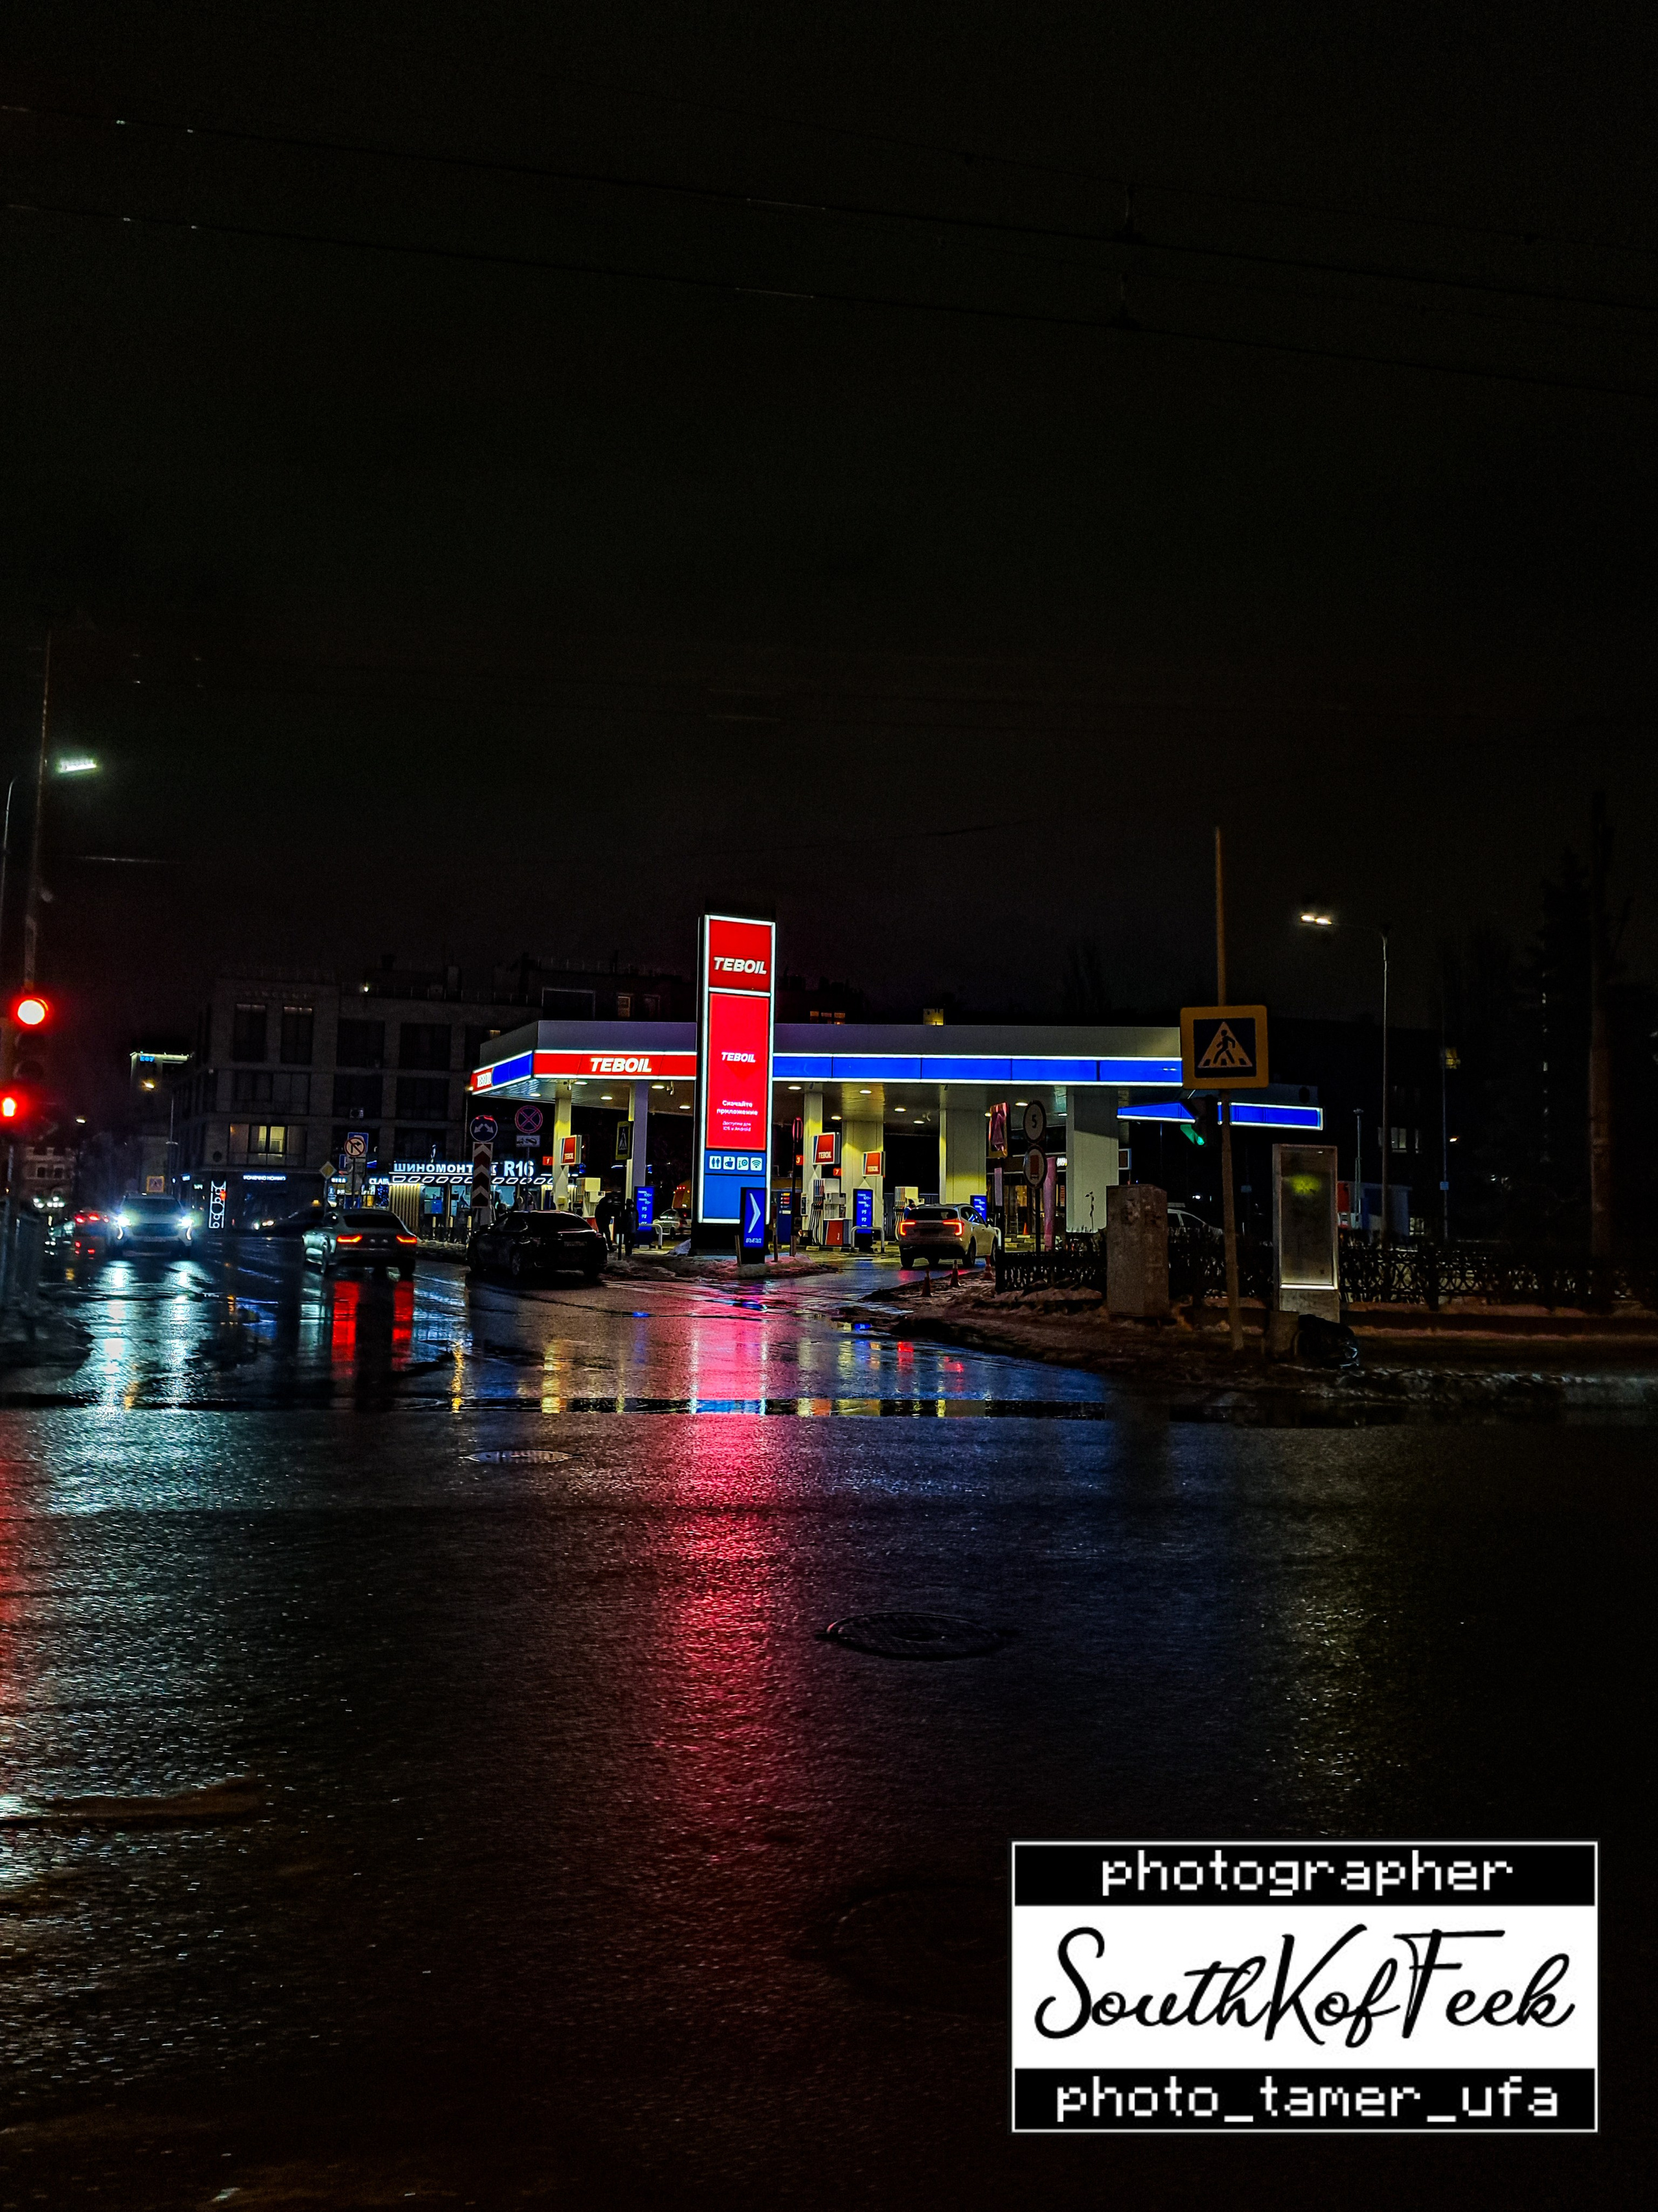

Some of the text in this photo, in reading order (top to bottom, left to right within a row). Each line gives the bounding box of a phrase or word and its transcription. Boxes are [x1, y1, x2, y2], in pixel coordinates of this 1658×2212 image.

[713, 956, 767, 975] TEBOIL
[591, 1057, 652, 1072] TEBOIL
[721, 1052, 756, 1063] TEBOIL
[1031, 1114, 1037, 1128] 5
[504, 1161, 534, 1177] R16
